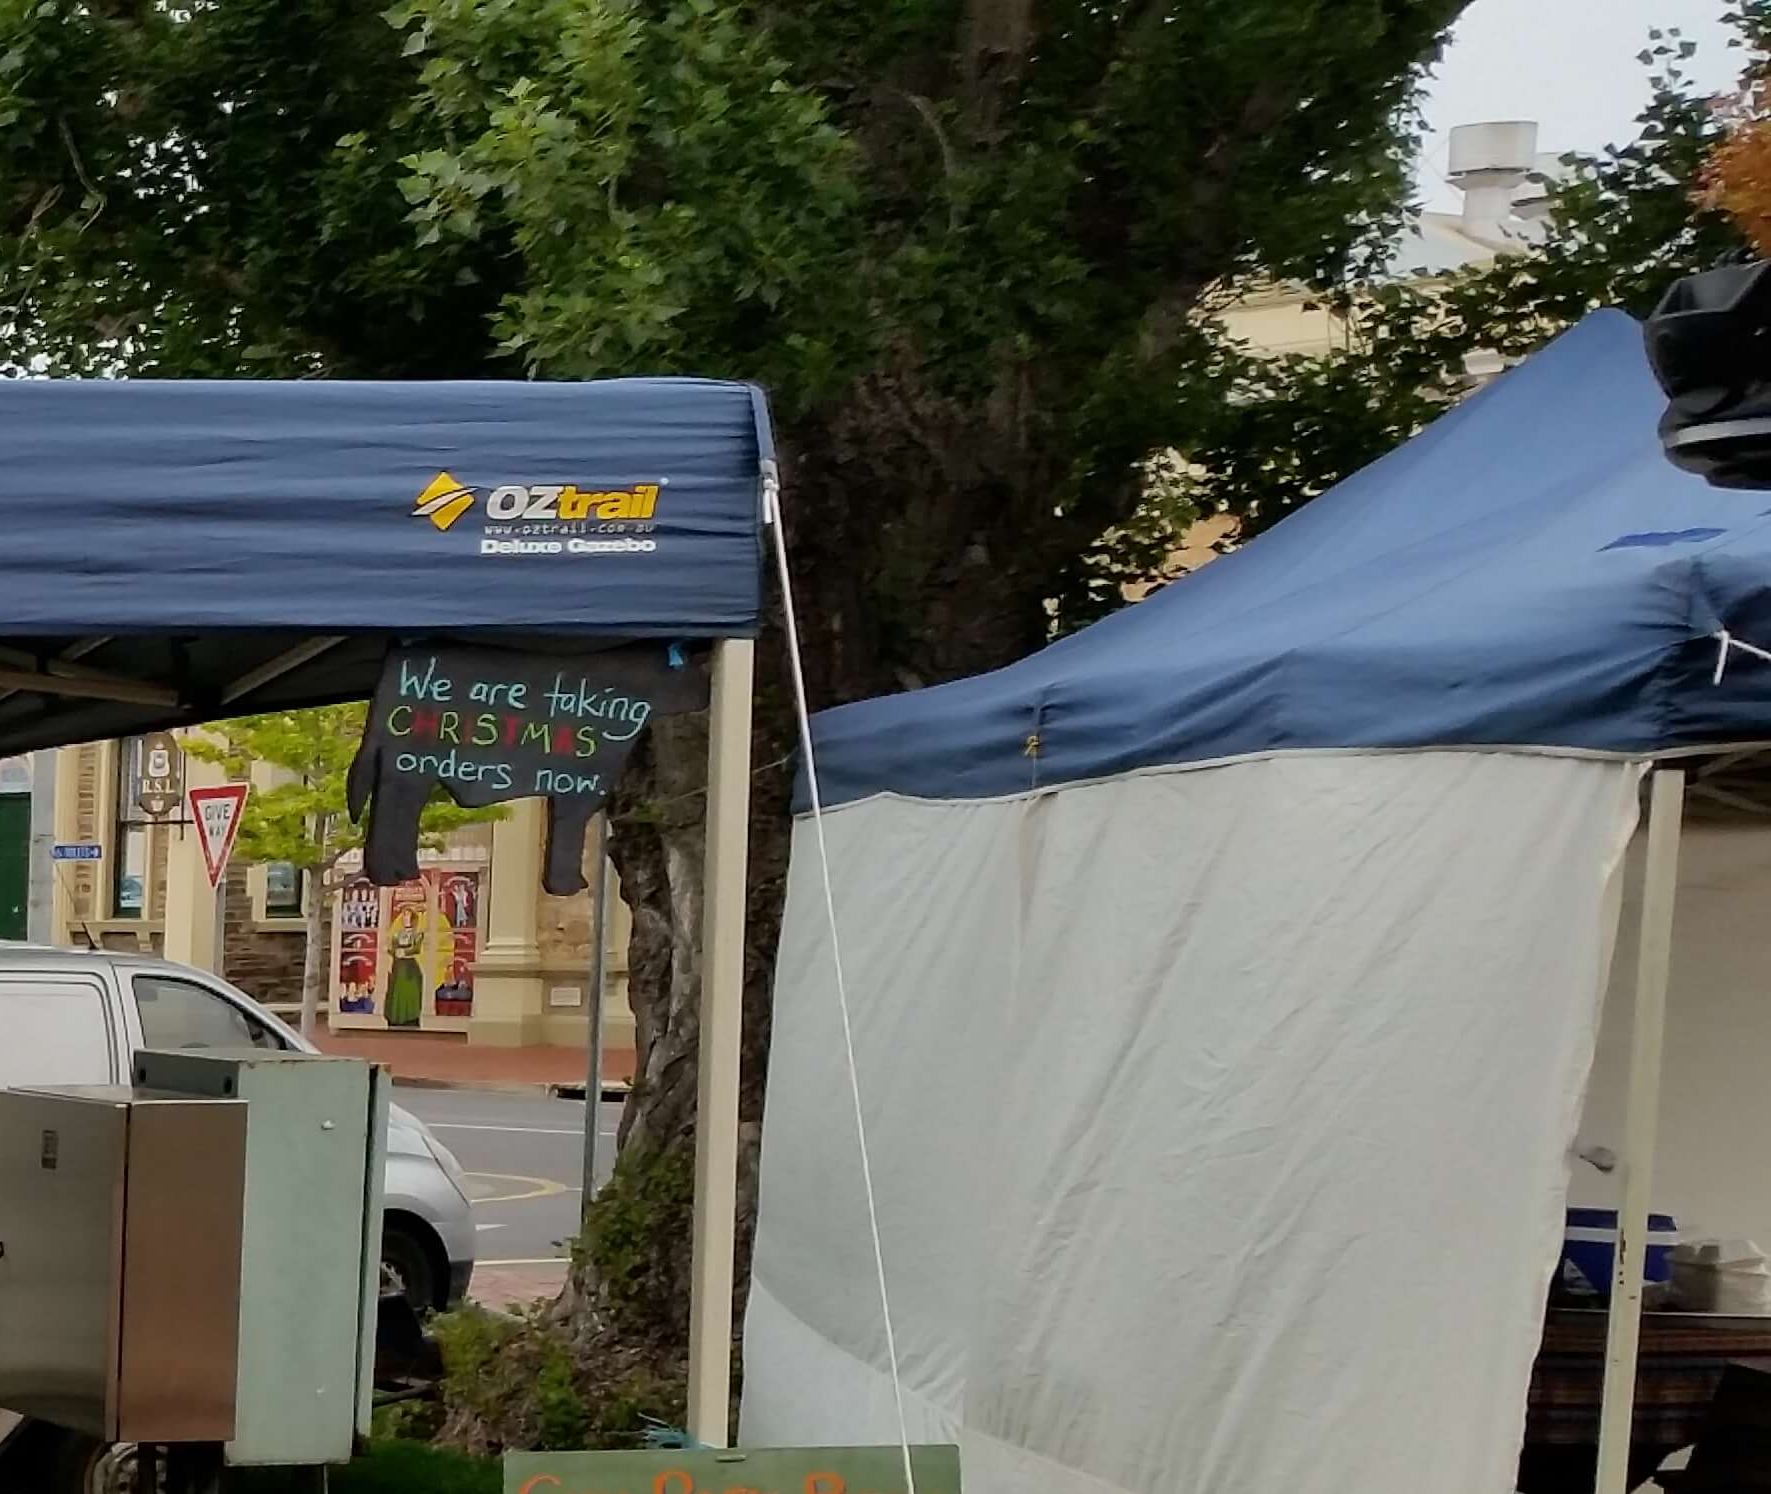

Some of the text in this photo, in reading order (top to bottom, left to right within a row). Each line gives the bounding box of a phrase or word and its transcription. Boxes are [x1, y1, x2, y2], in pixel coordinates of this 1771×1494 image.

[485, 484, 659, 520] OZtrail
[480, 538, 657, 555] Deluxe Gazebo
[399, 655, 651, 742] We are taking
[387, 705, 598, 758] CHRISTMAS
[396, 750, 606, 796] orders now.
[204, 803, 231, 821] GIVE
